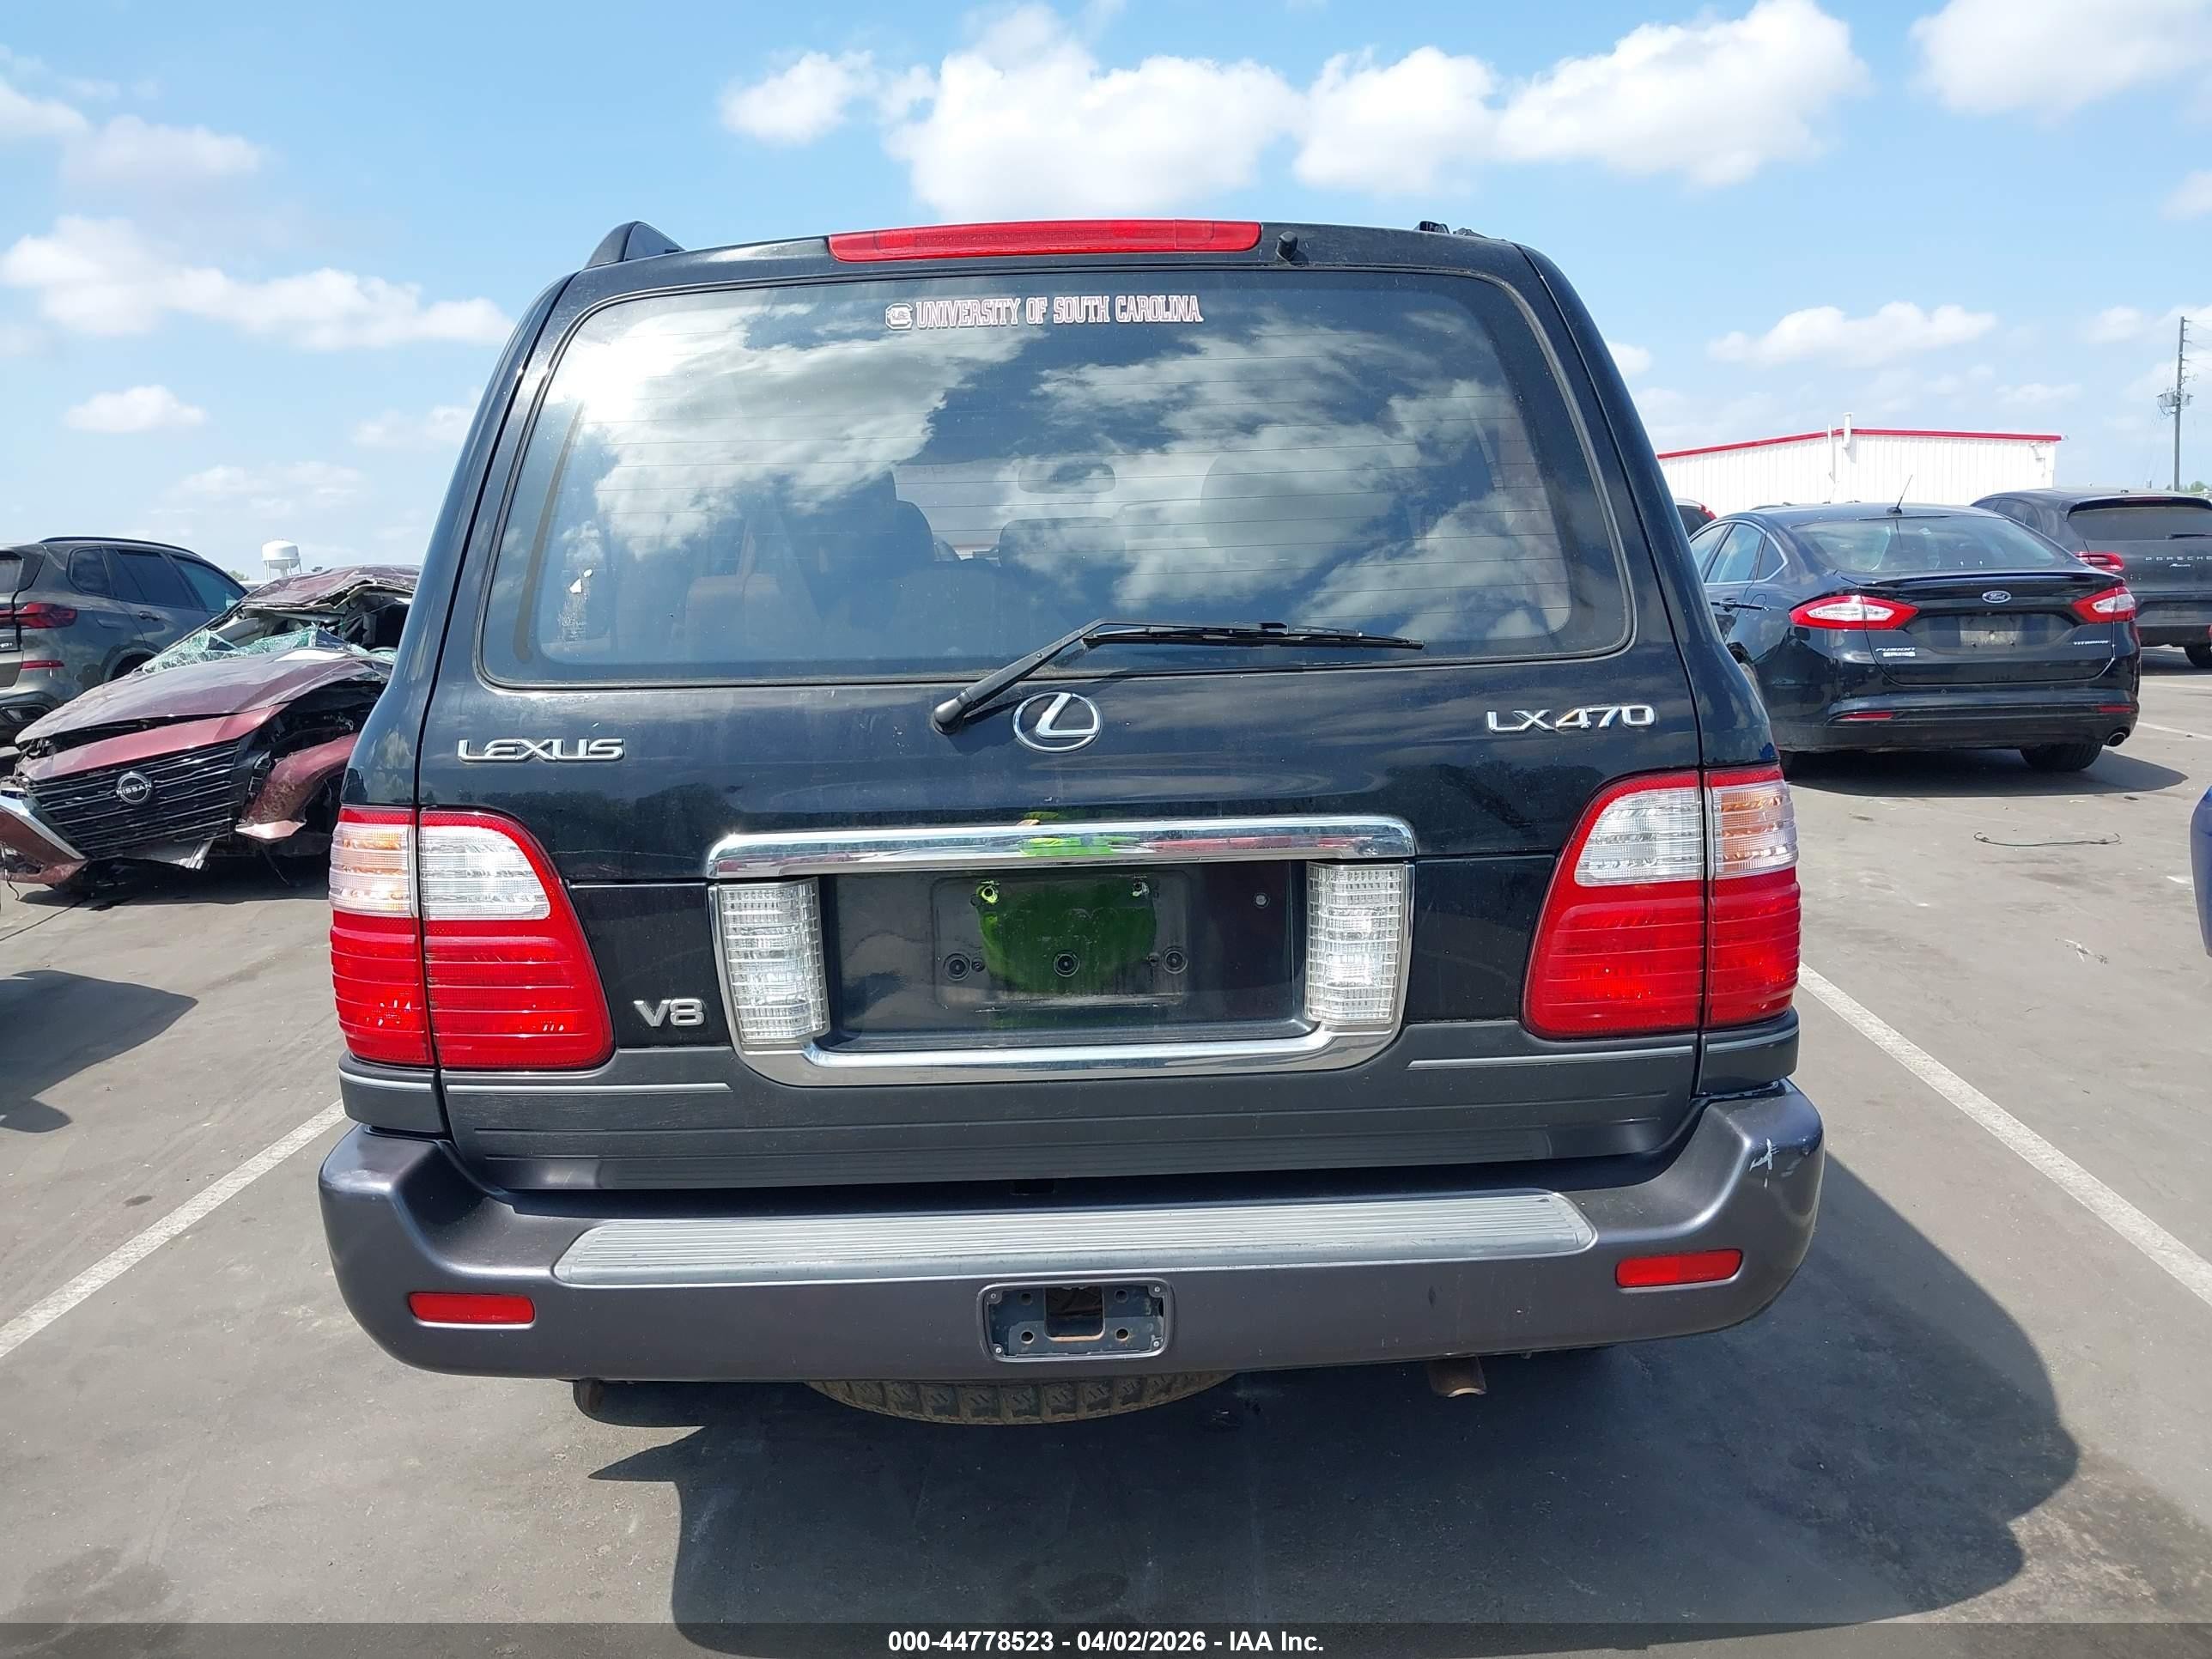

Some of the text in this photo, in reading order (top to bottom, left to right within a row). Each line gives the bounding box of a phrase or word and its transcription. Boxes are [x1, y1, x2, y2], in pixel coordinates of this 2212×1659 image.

[915, 295, 1205, 329] UNIVERSITY OF SOUTH CAROLINA
[458, 738, 624, 763] LEXUS
[116, 782, 152, 795] NISSAN
[634, 998, 705, 1027] V8
